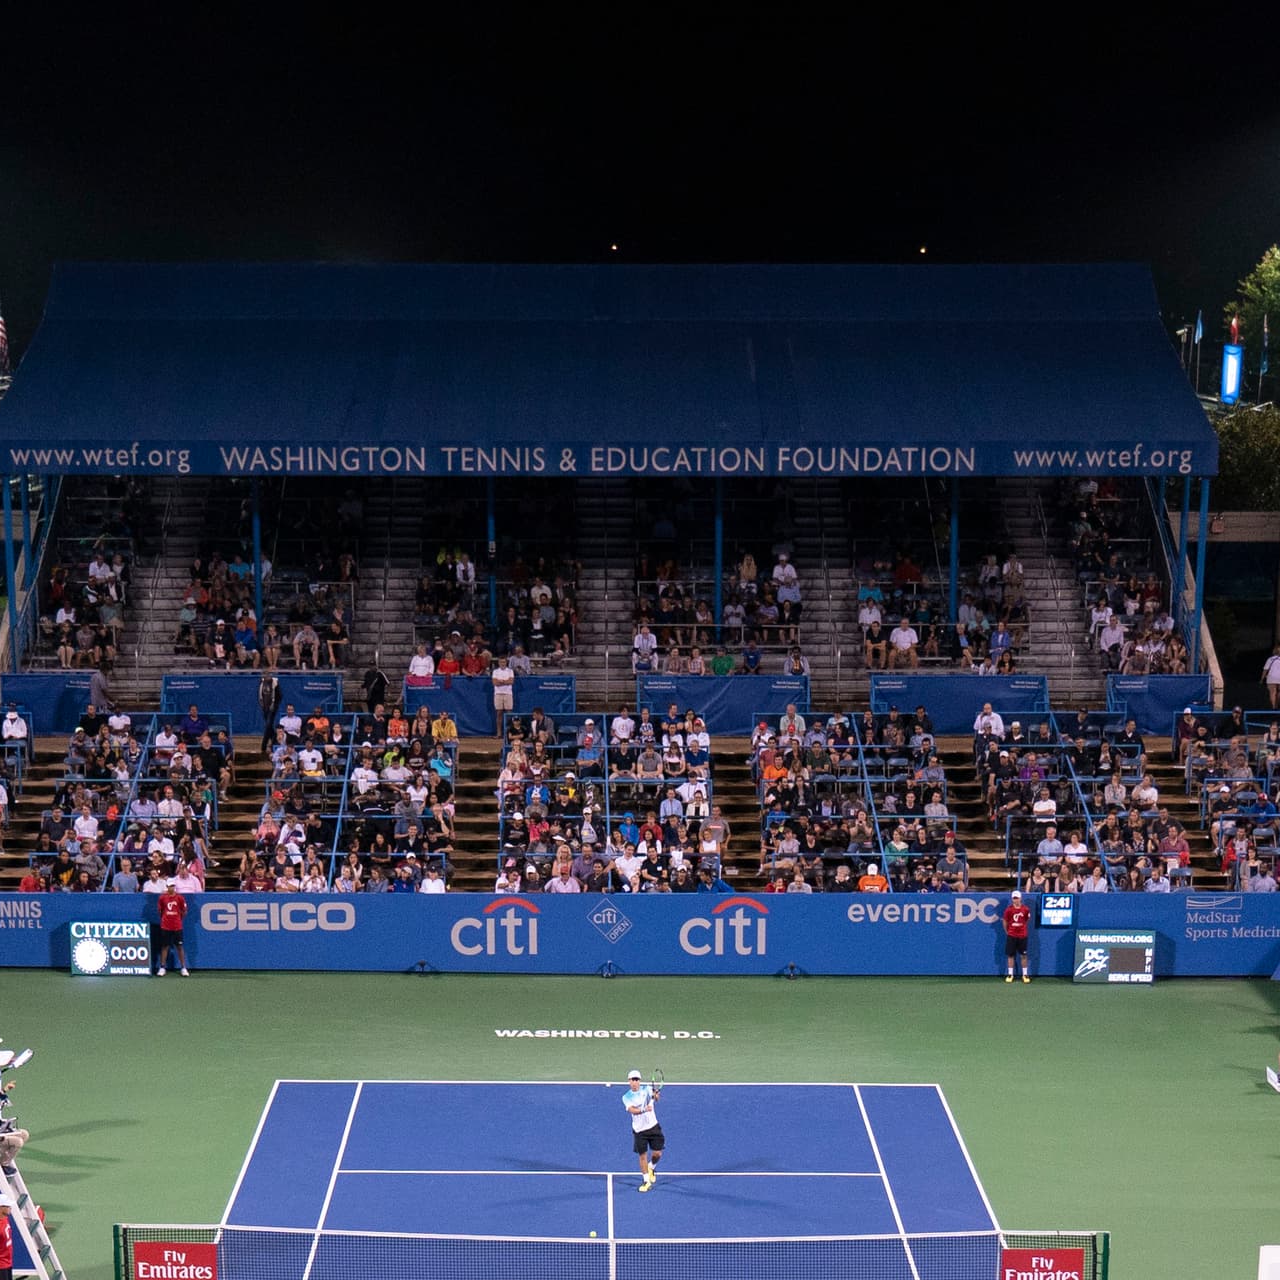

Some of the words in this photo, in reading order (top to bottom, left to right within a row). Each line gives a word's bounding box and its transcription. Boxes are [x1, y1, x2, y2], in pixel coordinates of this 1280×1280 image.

[10, 441, 191, 473] www.wtef.org
[220, 446, 426, 472] WASHINGTON
[441, 447, 546, 472] TENNIS
[559, 447, 577, 472] &
[591, 447, 765, 473] EDUCATION
[778, 447, 975, 473] FOUNDATION
[1014, 443, 1193, 474] www.wtef.org
[1045, 897, 1070, 909] 2:41
[200, 901, 356, 932] GEICO
[592, 909, 617, 925] citi
[847, 897, 1000, 925] eventsDC
[1185, 912, 1242, 924] MedStar
[450, 905, 538, 956] citi
[607, 919, 631, 941] OPEN
[679, 905, 767, 956] citi
[1184, 926, 1235, 941] Sports
[1078, 934, 1153, 944] WASHINGTON.ORG
[111, 946, 149, 960] 0:00
[1085, 948, 1105, 960] DC
[110, 967, 133, 975] MATCH
[134, 967, 150, 975] TIME
[1108, 973, 1130, 982] SERVE
[1130, 973, 1153, 982] SPEED
[494, 1029, 667, 1040] WASHINGTON,
[673, 1030, 721, 1039] D.C.
[163, 1250, 186, 1265] Fly
[1031, 1256, 1054, 1271] Fly
[137, 1261, 213, 1280] Emirates
